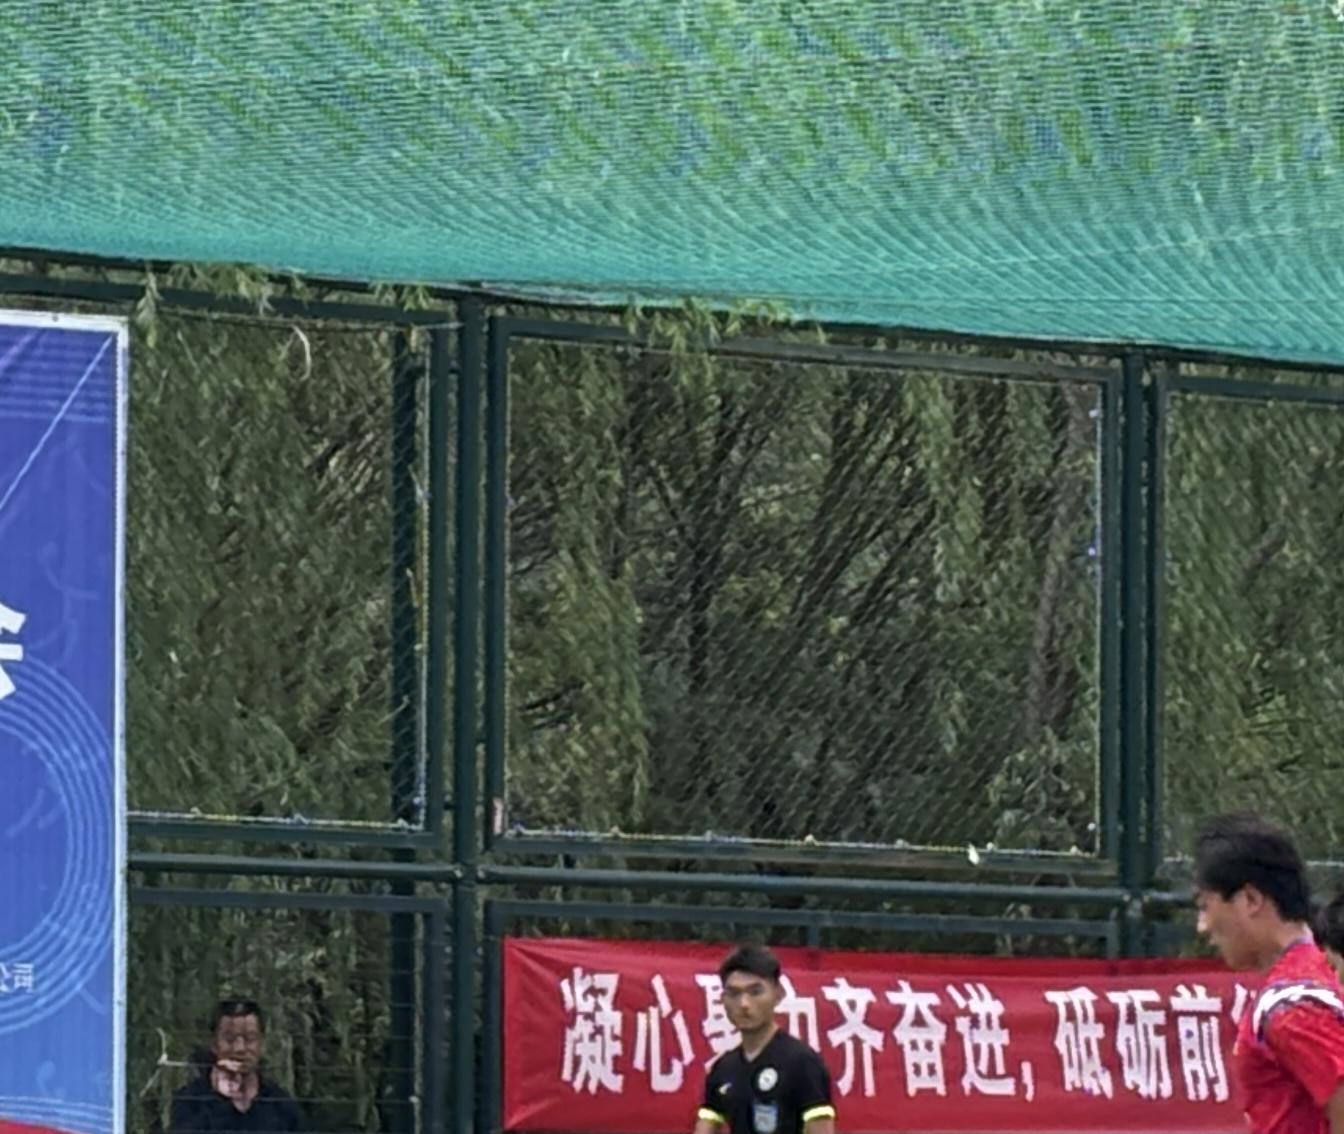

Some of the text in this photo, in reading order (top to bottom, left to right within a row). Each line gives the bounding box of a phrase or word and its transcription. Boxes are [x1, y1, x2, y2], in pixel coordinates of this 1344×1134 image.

[560, 966, 1258, 1102] 凝心聚力齐奋进，砥砺前
